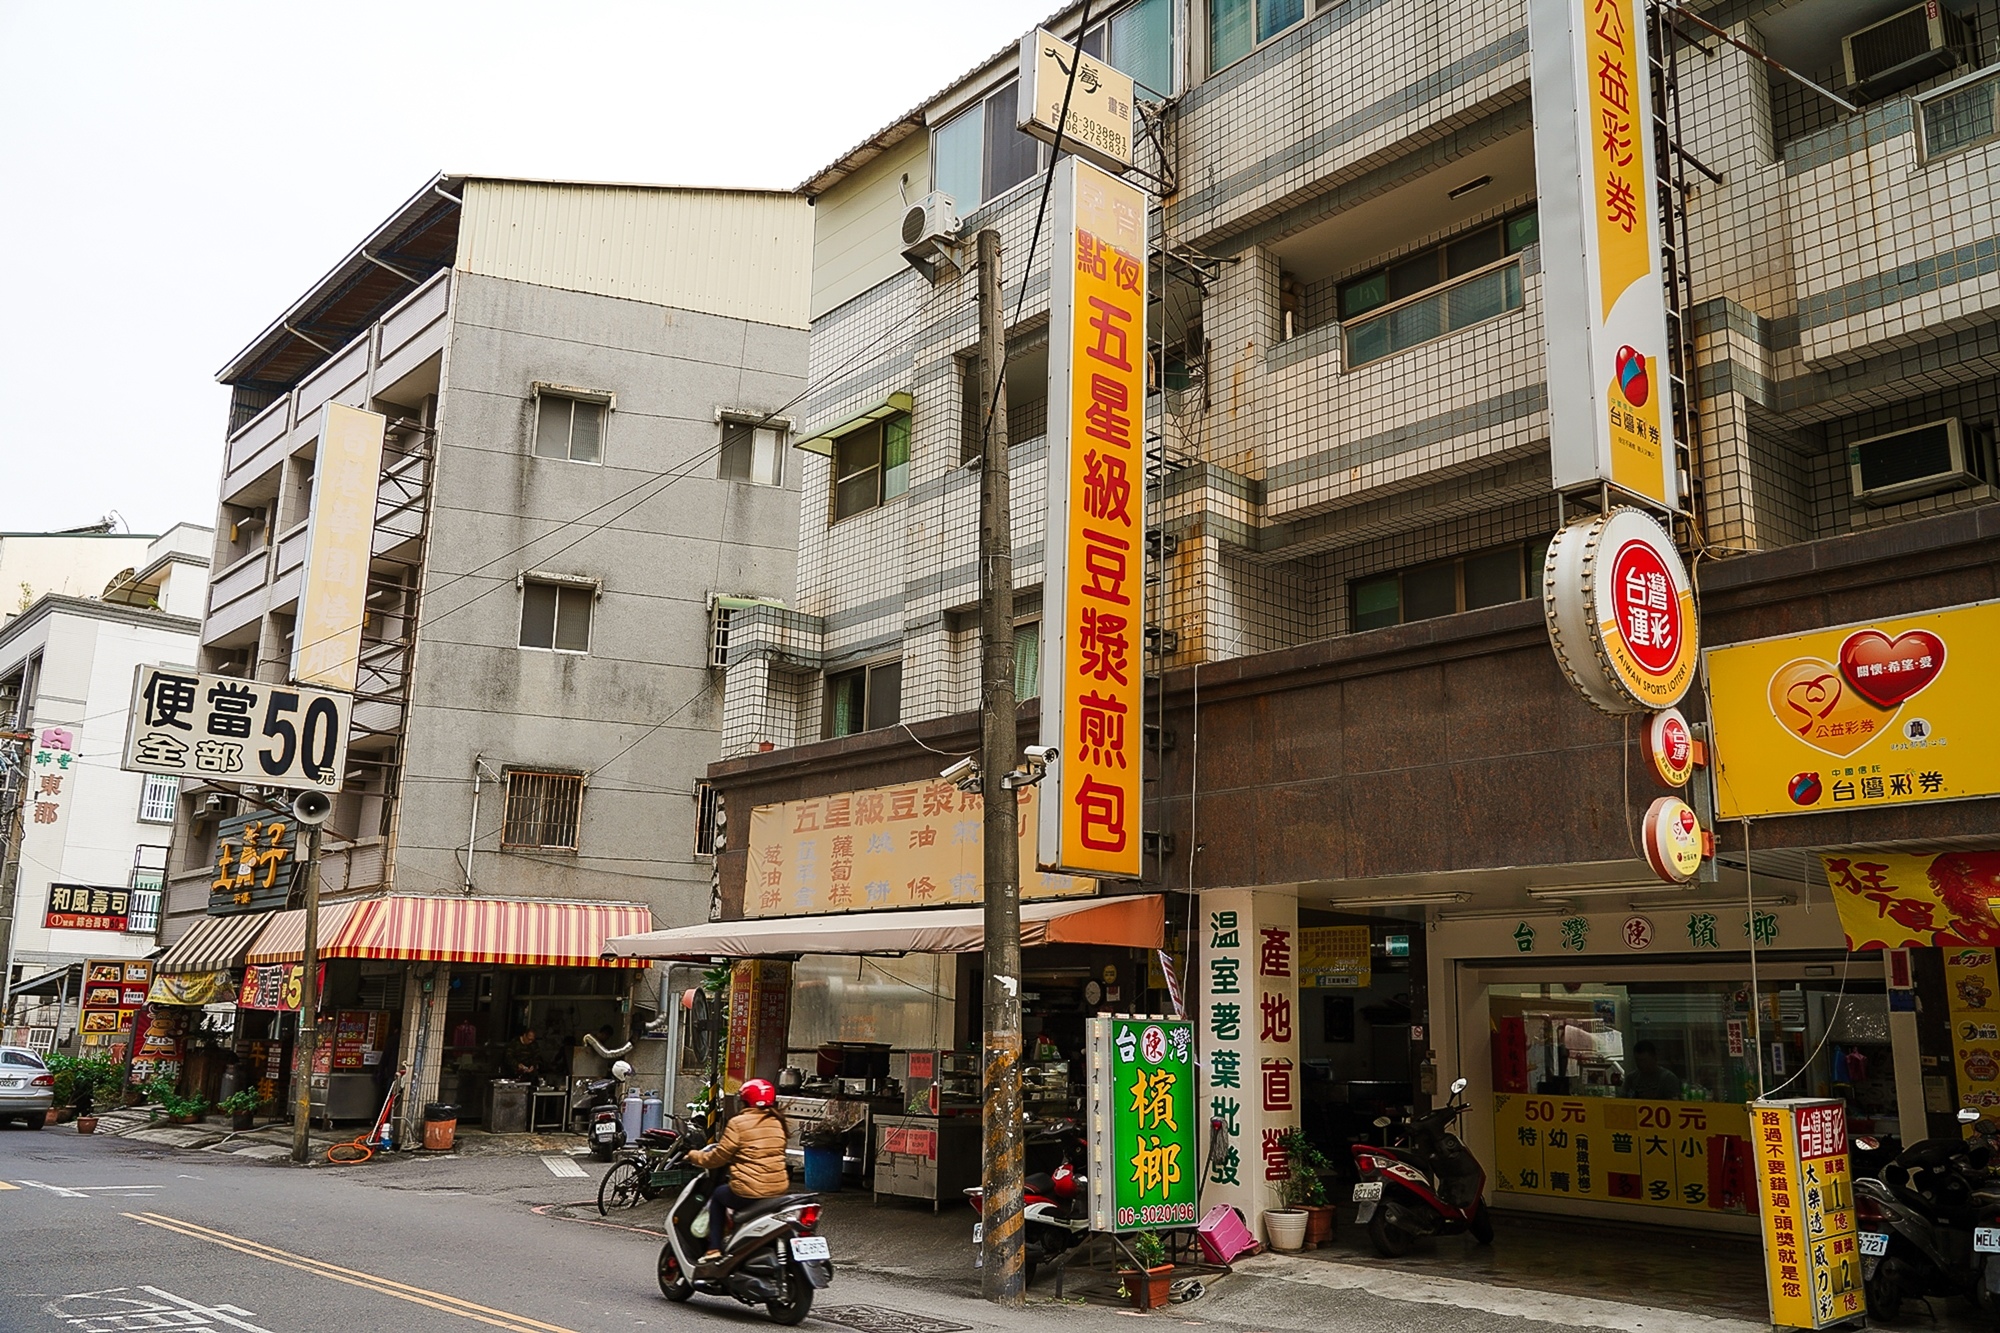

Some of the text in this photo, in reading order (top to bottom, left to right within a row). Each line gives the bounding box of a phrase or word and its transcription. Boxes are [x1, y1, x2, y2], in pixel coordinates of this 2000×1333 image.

[1065, 121, 1128, 157] 06-2753837
[1610, 405, 1660, 445] 台灣彩券
[1075, 294, 1133, 853] 五星級豆漿煎包
[1625, 566, 1668, 611] 台灣
[1627, 605, 1673, 650] 運彩
[1615, 646, 1688, 696] TAIWAN SPORTS LOTTERY
[142, 670, 258, 739] 便當
[258, 690, 339, 786] 50 元
[1815, 718, 1875, 739] 公益彩券
[135, 732, 244, 773] 全部
[1831, 764, 1882, 777] 中國信託
[33, 773, 64, 825] 東郡
[1832, 770, 1944, 802] 台灣彩券
[906, 823, 938, 900] 油條
[52, 887, 129, 915] 和風壽司
[1825, 858, 1947, 933] 狂賀
[1511, 910, 1780, 954] 台灣 陳 檳榔
[1947, 952, 1993, 969] 威力彩
[1115, 1024, 1193, 1065] 台 陳 灣
[131, 1060, 181, 1080] 牛排
[1129, 1067, 1182, 1201] 檳榔
[1524, 1100, 1707, 1131] 50元 20元
[1800, 1107, 1844, 1158] 台灣運彩
[1823, 1157, 1846, 1175] 頭獎
[1117, 1202, 1195, 1228] 06-3020196
[1805, 1163, 1824, 1235] 大樂透
[1833, 1213, 1849, 1231] 億
[1832, 1237, 1855, 1256] 頭獎
[1812, 1243, 1834, 1320] 威力彩
[1842, 1293, 1858, 1312] 億
